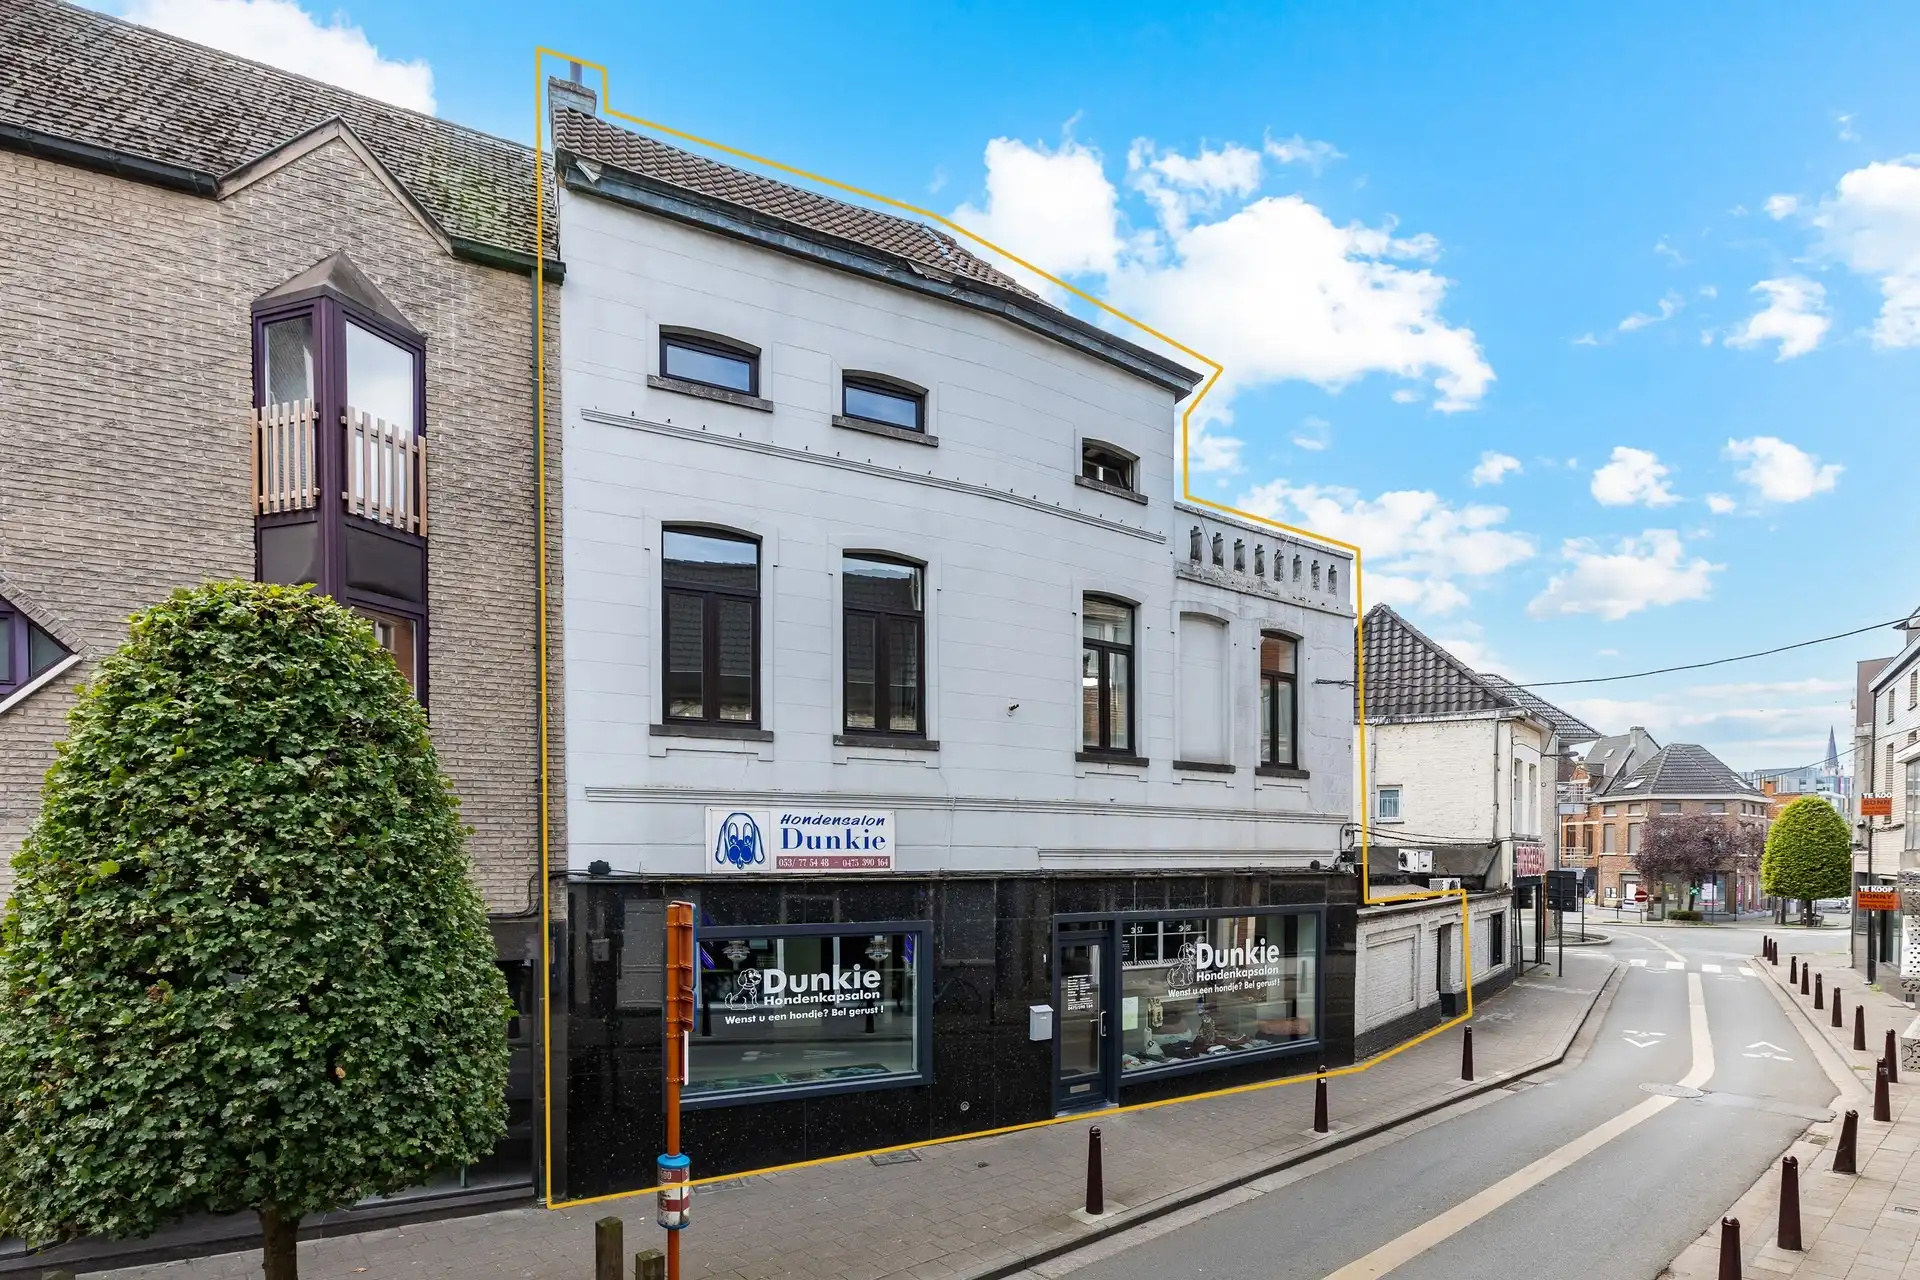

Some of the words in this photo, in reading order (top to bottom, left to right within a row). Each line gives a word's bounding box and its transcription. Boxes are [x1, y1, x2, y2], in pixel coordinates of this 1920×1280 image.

[780, 814, 885, 826] Hondensalon
[780, 828, 886, 850] Dunkie
[778, 858, 795, 867] 053/
[799, 858, 806, 867] 77
[809, 858, 818, 867] 54
[820, 858, 829, 867] 48
[842, 859, 859, 867] 0475
[862, 858, 874, 867] 390
[877, 858, 888, 867] 164
[1871, 885, 1893, 893] KOOP
[1196, 937, 1280, 970] Dunkie
[764, 964, 881, 994] Dunkie
[1196, 965, 1279, 982] Hondenkapsalon
[1168, 987, 1191, 998] Wenst
[1199, 985, 1213, 994] een
[1214, 981, 1242, 993] hondje?
[1244, 980, 1255, 990] Bel
[764, 990, 880, 1006] Hondenkapsalon
[725, 1015, 756, 1025] Wenst
[768, 1013, 787, 1021] een
[789, 1008, 828, 1020] hondje?
[831, 1008, 846, 1017] Bel
